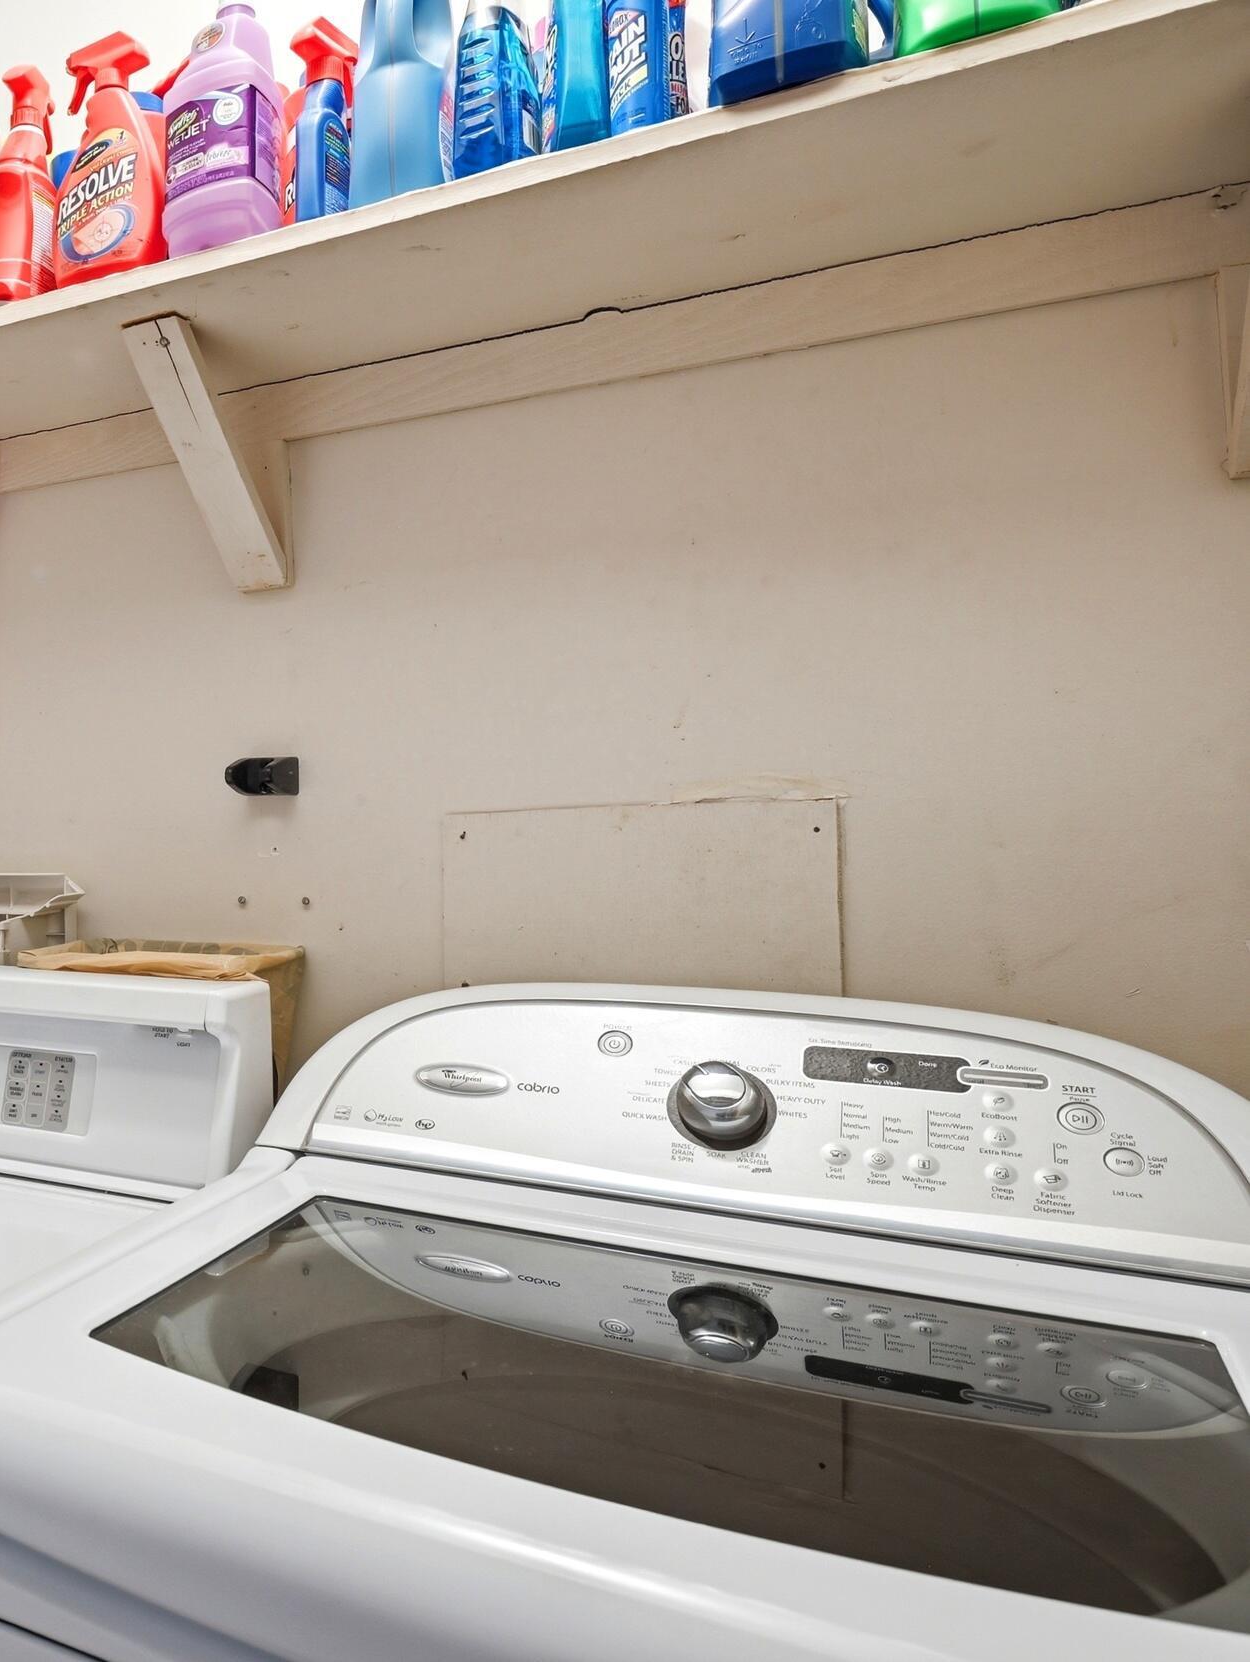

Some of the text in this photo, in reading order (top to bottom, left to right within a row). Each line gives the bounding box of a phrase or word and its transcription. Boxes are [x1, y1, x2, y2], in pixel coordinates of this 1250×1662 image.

[58, 153, 138, 228] RESOLVE
[90, 182, 134, 210] ACTION
[1005, 1064, 1038, 1073] Monitor
[517, 1082, 560, 1095] cabrio
[1062, 1085, 1096, 1094] START
[803, 1097, 826, 1105] DUTY
[622, 1111, 646, 1120] QUICK
[778, 1110, 808, 1119] WHITES
[1110, 1132, 1134, 1141] Cycle
[1109, 1139, 1136, 1147] Signal
[706, 1151, 727, 1159] SOAK
[741, 1151, 767, 1160] CLEAN
[1056, 1157, 1069, 1165] Off
[825, 1173, 846, 1181] Level
[866, 1177, 891, 1186] Speed
[913, 1183, 936, 1193] Temp
[991, 1186, 1014, 1195] Deep
[991, 1193, 1015, 1201] Clean
[1033, 1205, 1075, 1216] Dispenser
